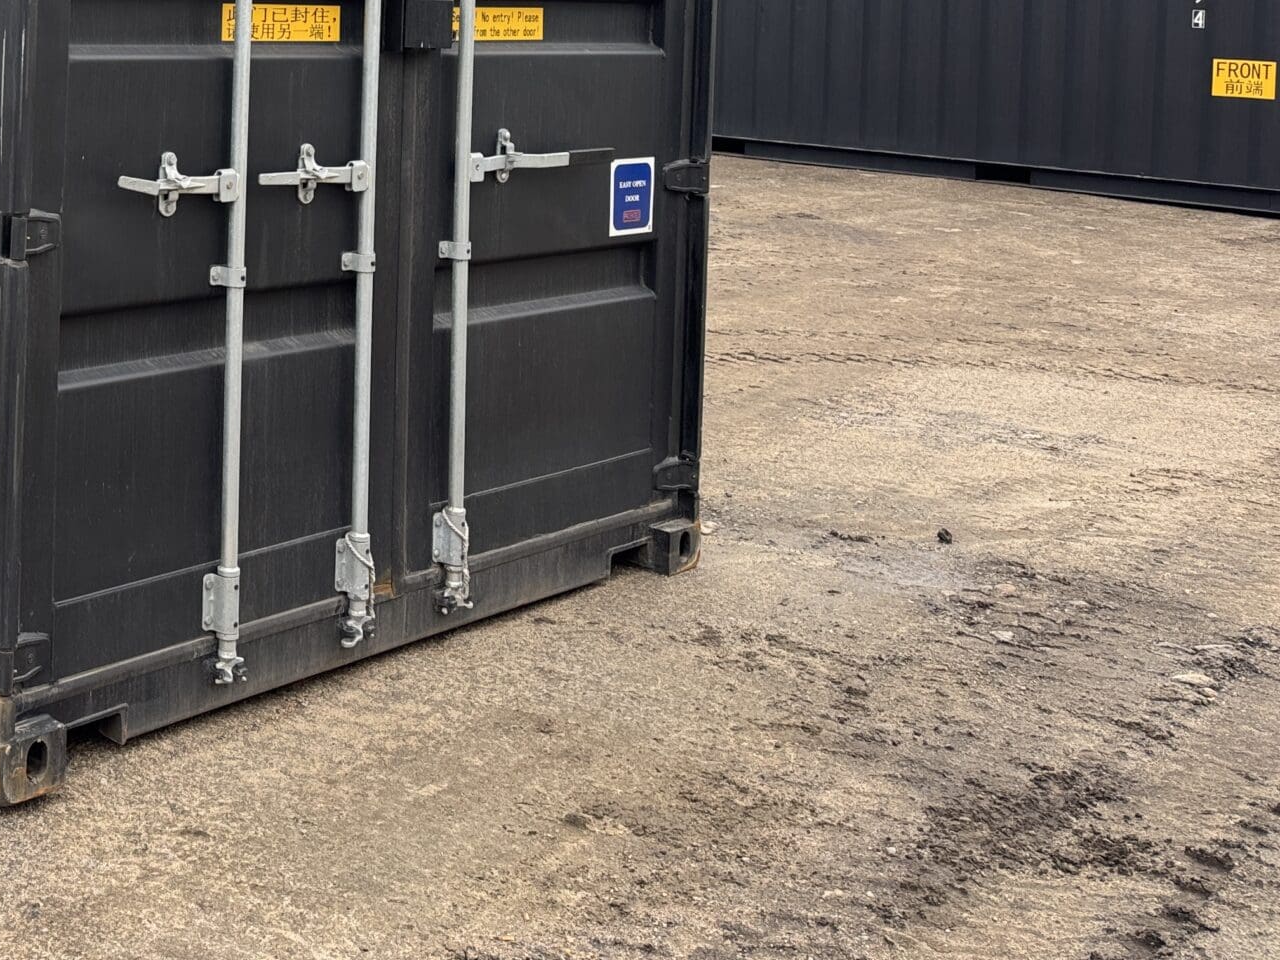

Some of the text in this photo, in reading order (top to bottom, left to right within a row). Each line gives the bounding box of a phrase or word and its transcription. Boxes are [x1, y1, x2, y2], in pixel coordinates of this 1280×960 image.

[481, 11, 489, 22] No
[517, 11, 540, 22] Please
[490, 26, 501, 37] the
[1216, 61, 1273, 80] FRONT
[1224, 79, 1263, 97] 前端
